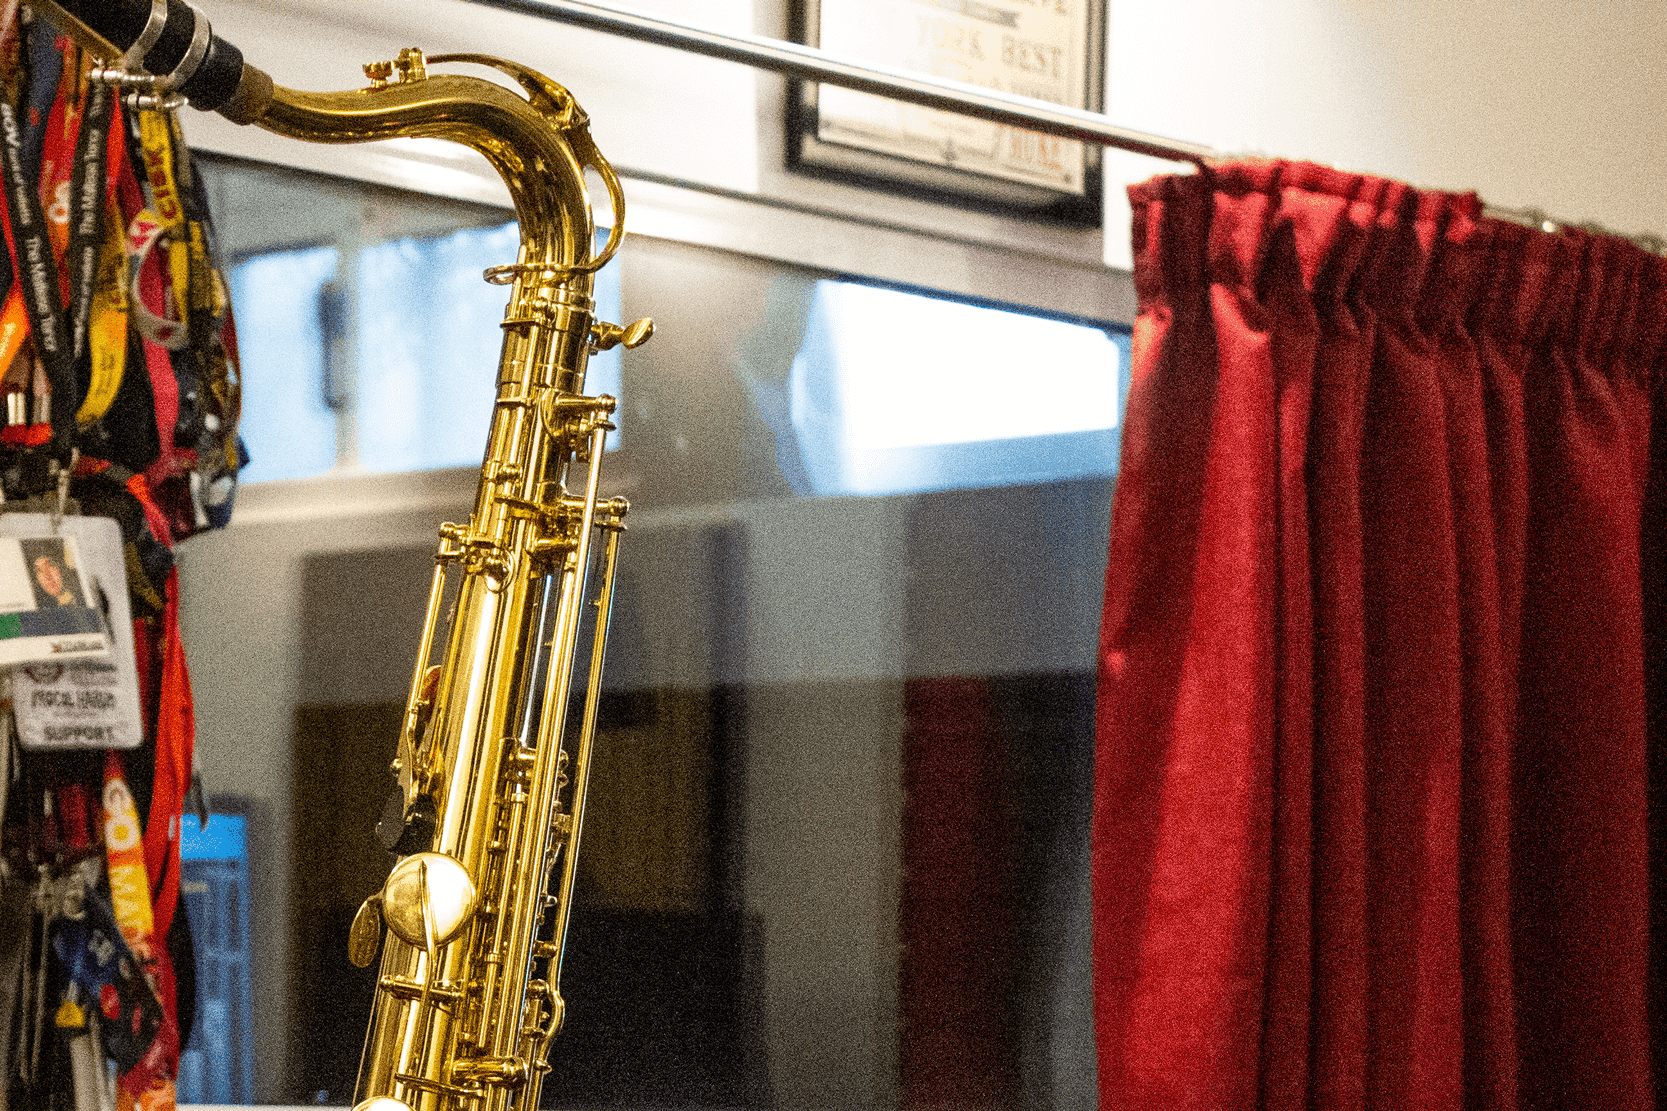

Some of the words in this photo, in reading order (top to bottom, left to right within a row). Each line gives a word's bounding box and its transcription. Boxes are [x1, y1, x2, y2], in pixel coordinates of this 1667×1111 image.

[1001, 34, 1063, 79] BEST
[0, 103, 21, 149] BOV
[83, 128, 101, 161] Tenor
[80, 162, 101, 211] Maltese
[145, 149, 179, 221] CISK
[78, 211, 97, 237] The
[26, 238, 44, 262] The
[31, 262, 52, 314] Maltese
[41, 315, 59, 353] Tenor
[43, 725, 114, 742] SUPPORT
